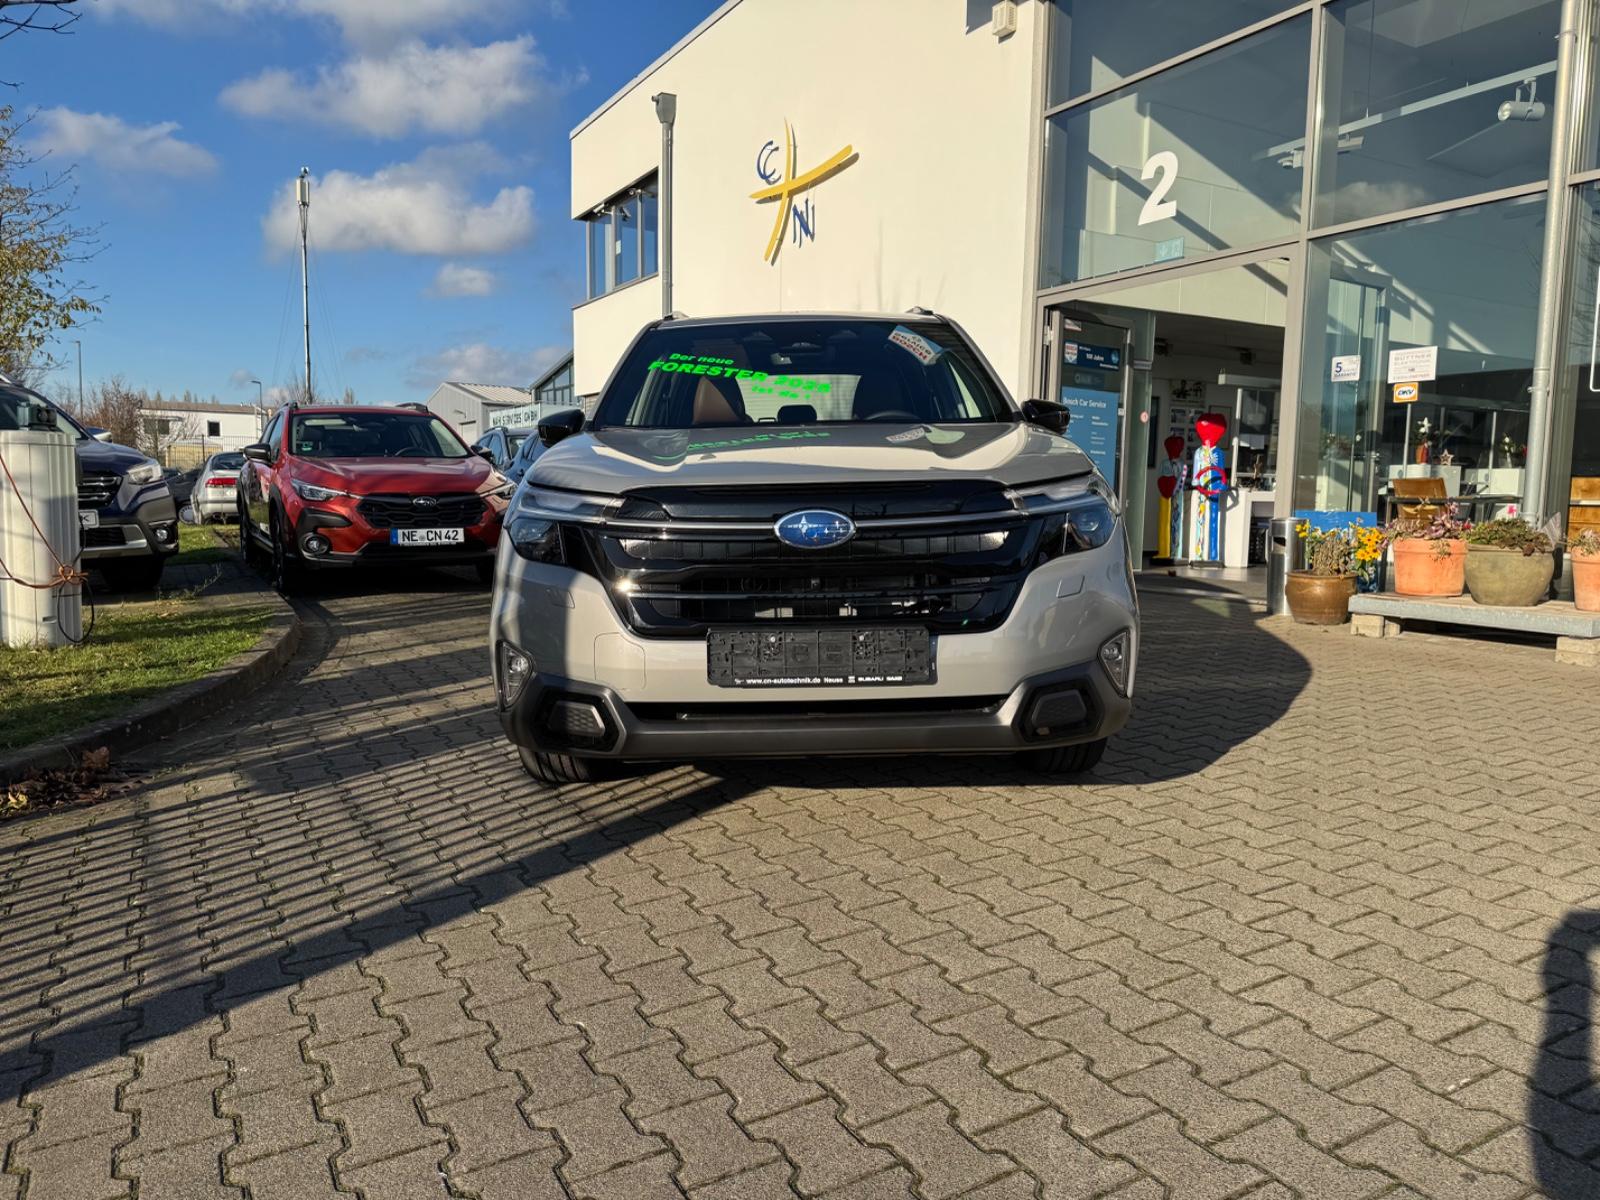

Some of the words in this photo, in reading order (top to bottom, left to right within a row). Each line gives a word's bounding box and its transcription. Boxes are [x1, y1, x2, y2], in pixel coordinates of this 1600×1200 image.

[1137, 150, 1179, 226] 2
[669, 353, 696, 362] Der
[697, 356, 735, 365] neue
[648, 361, 769, 383] FORESTER
[1335, 361, 1343, 373] 5
[1063, 396, 1079, 407] Bosch
[1079, 398, 1088, 407] Car
[1089, 399, 1107, 409] Service
[402, 530, 418, 542] NE
[426, 530, 442, 542] CN
[444, 529, 459, 541] 42
